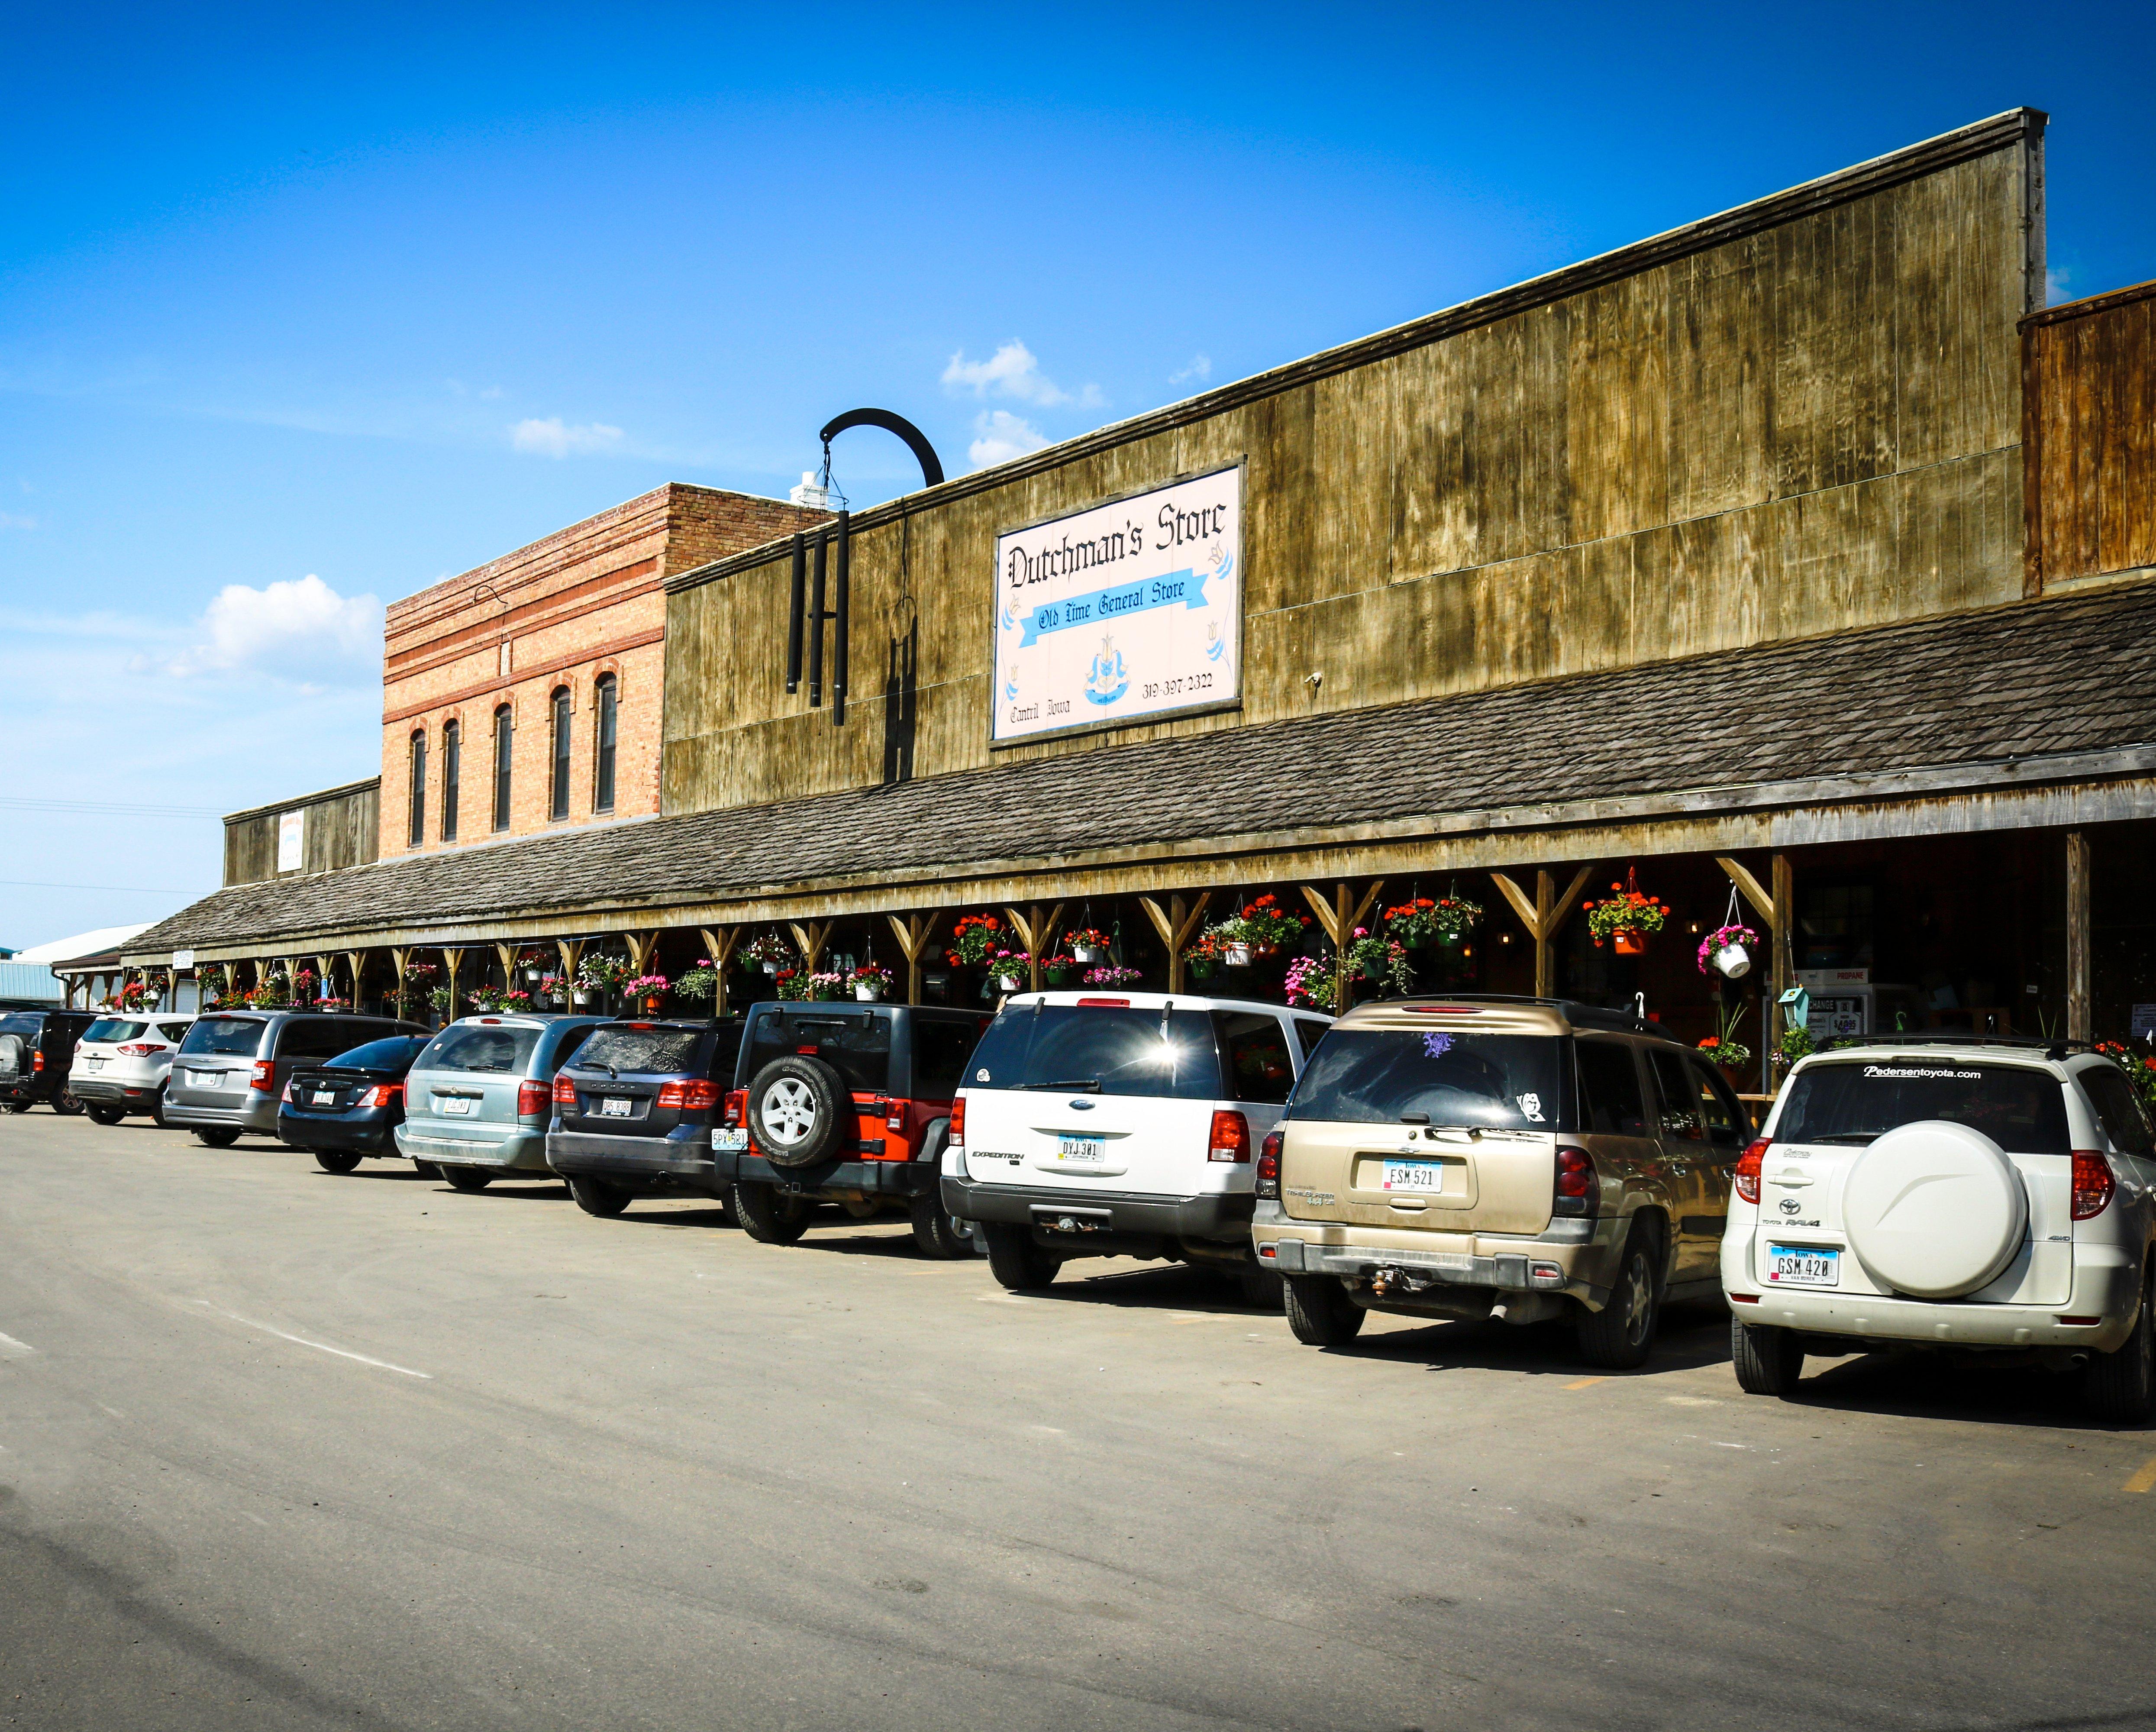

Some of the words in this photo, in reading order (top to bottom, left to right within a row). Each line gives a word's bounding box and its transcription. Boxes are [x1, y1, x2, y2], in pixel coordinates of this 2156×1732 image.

[1008, 520, 1143, 589] Dutchman's
[1156, 503, 1227, 550] Store
[1039, 607, 1059, 629] Old
[1065, 602, 1091, 622] Time
[1099, 586, 1144, 614] General
[1152, 582, 1185, 602] Store
[1143, 673, 1212, 698] 319-397-2322
[1010, 703, 1039, 723] Cantril
[1047, 699, 1070, 716] Iowa
[1837, 971, 1863, 980] PROPANE
[1808, 1000, 1833, 1009] CHANGE
[1863, 1066, 1981, 1079] Pedersentoyota.com
[616, 1102, 630, 1112] 8388
[713, 1134, 727, 1145] 5PX
[1063, 1142, 1079, 1154] DYJ
[1081, 1143, 1096, 1156] 301
[1391, 1169, 1410, 1184] ESM
[1414, 1170, 1432, 1185] 521
[1778, 1257, 1801, 1274] GSM
[1806, 1260, 1828, 1276] 420
